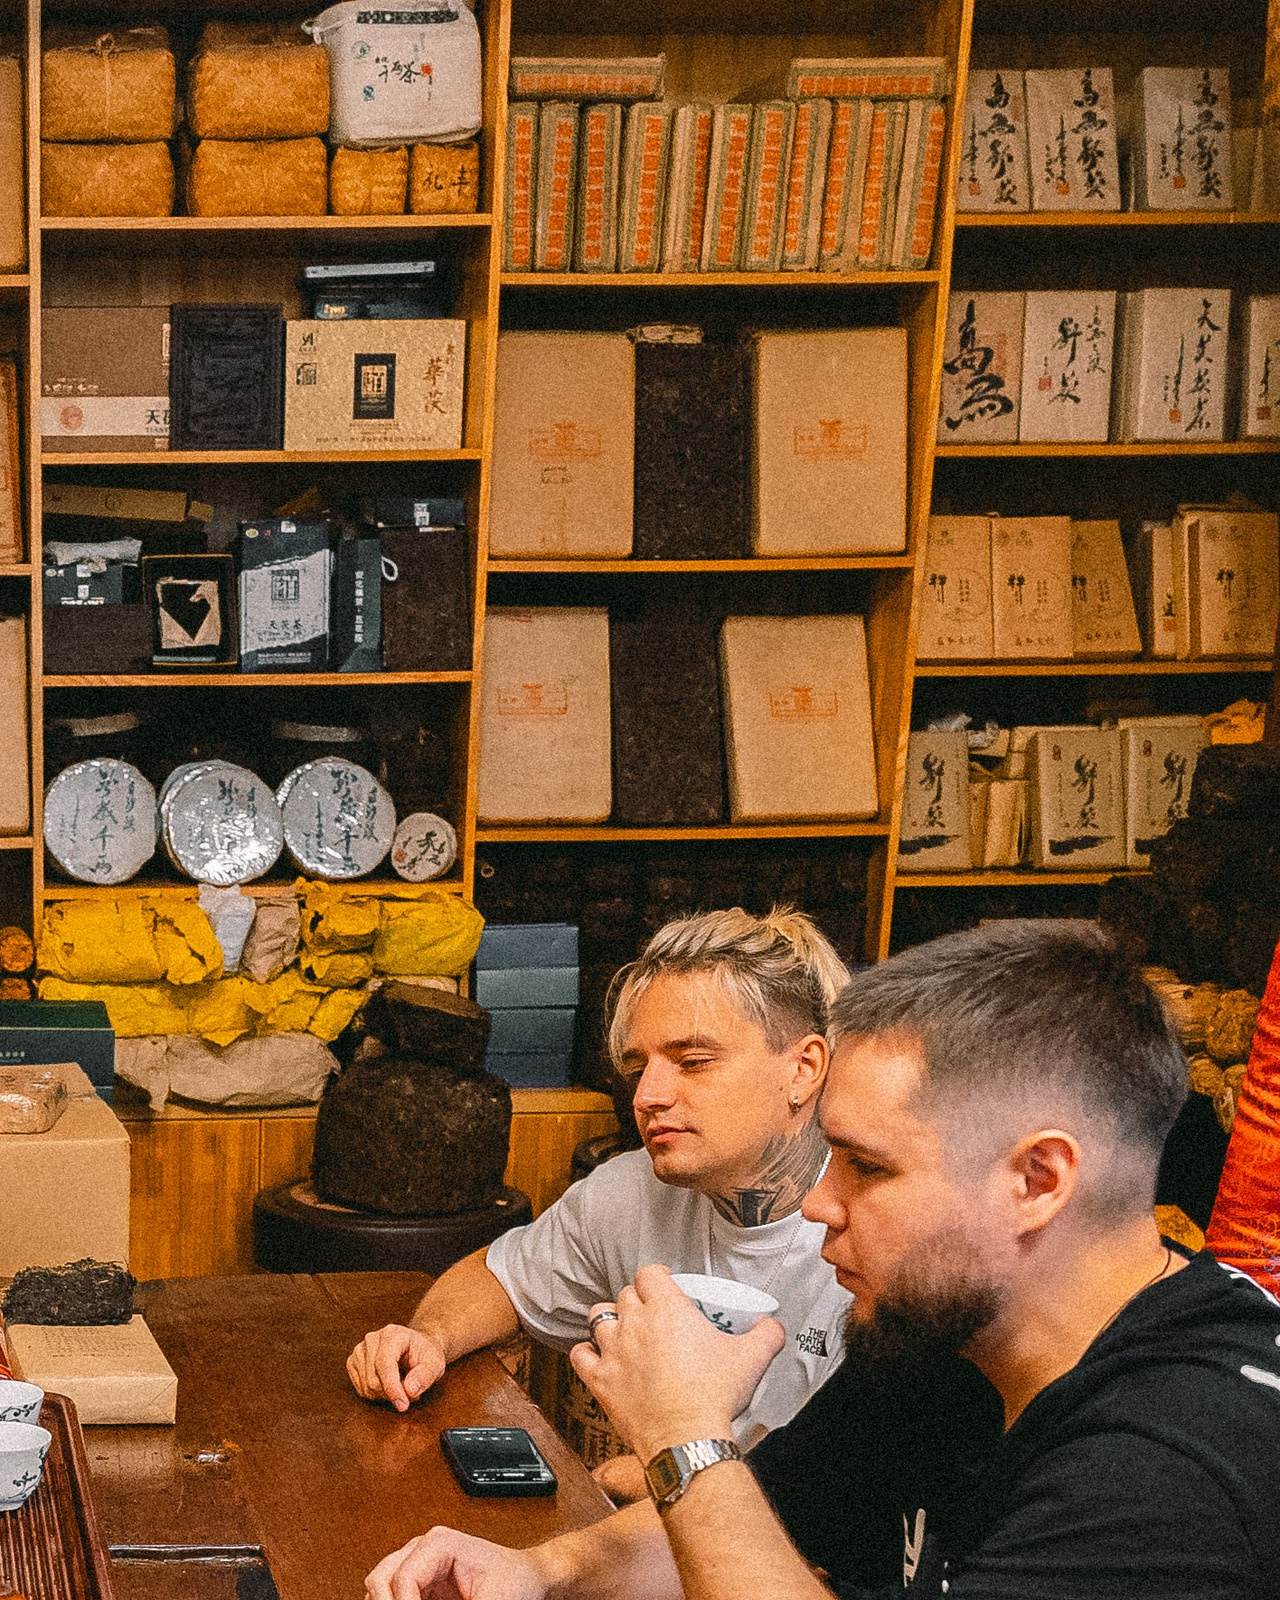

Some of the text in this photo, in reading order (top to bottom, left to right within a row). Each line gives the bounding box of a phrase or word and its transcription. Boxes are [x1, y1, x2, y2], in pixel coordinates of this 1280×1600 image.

[145, 408, 169, 425] 天
[808, 1327, 825, 1338] THE
[799, 1342, 821, 1355] FACE
